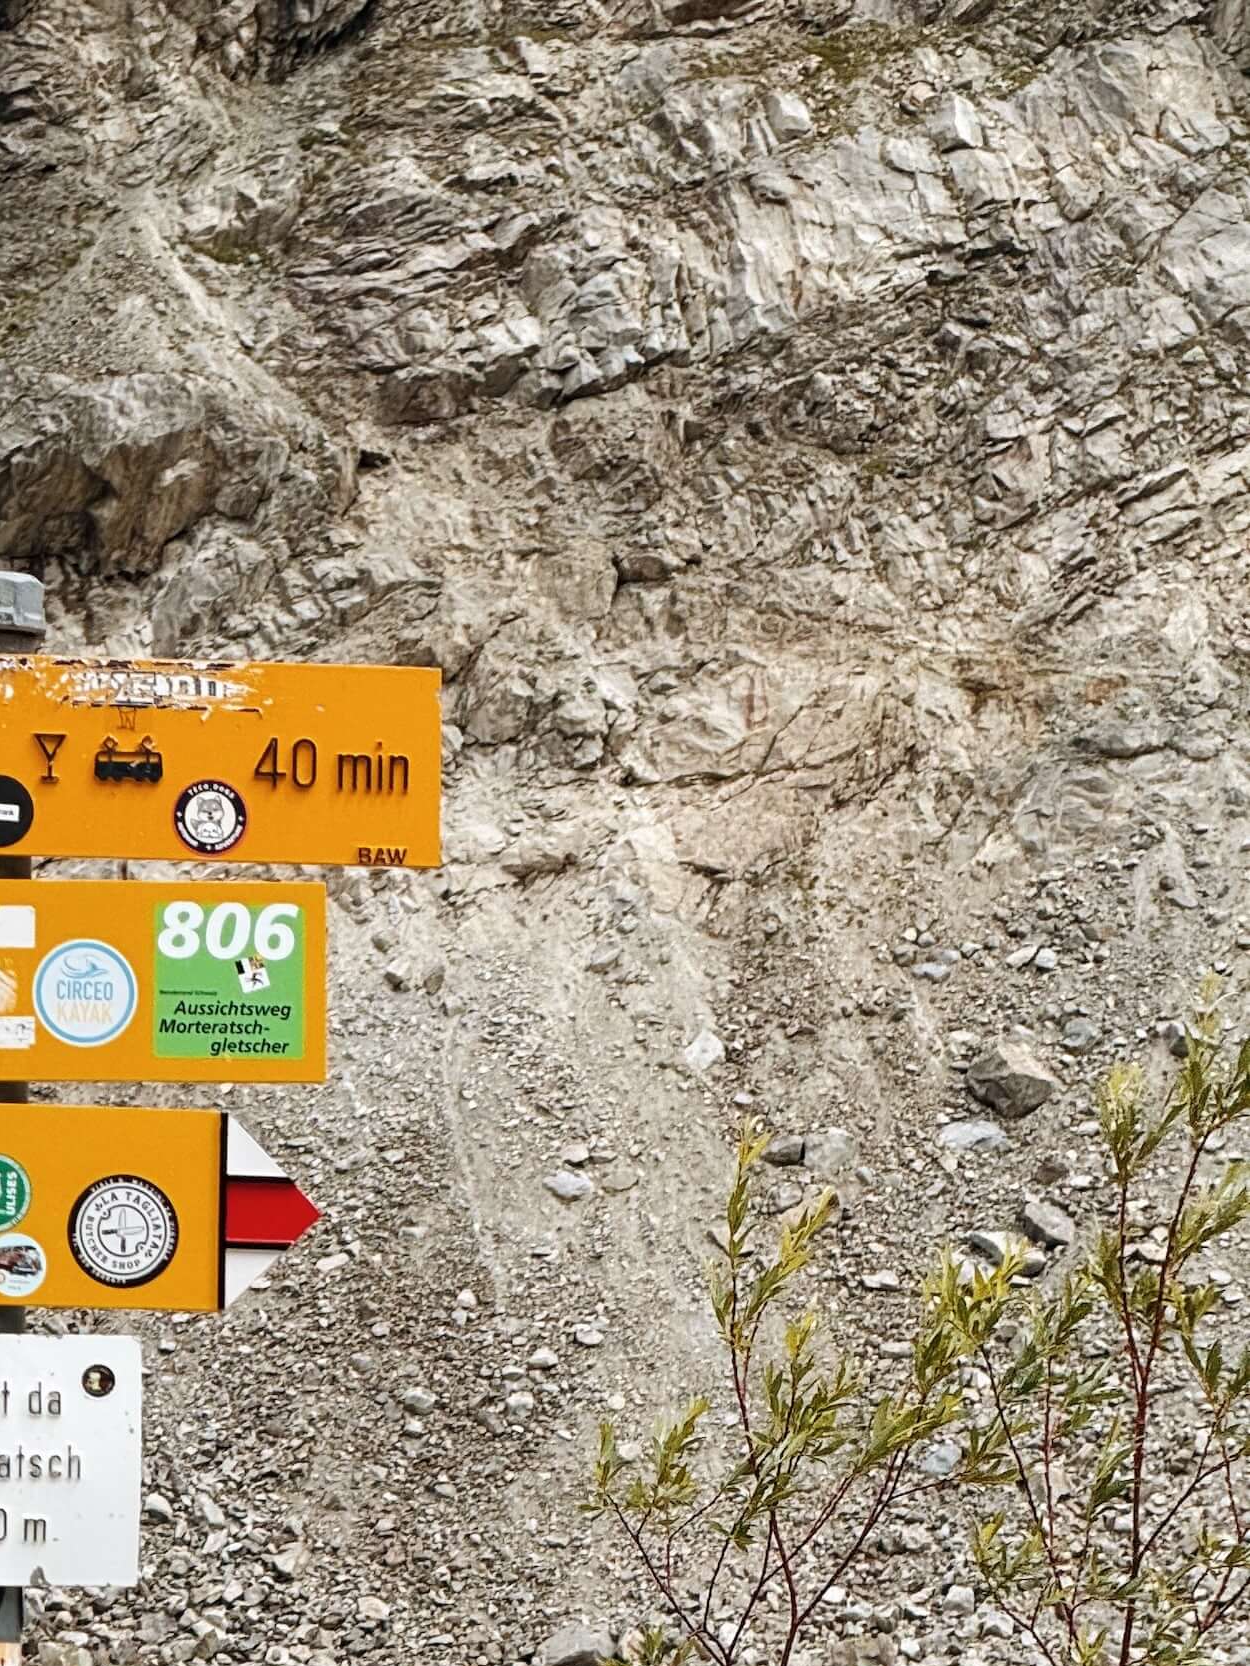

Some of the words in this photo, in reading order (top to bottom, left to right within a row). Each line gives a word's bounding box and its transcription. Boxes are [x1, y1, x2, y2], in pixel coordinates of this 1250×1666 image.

[254, 737, 318, 790] 40
[337, 741, 410, 794] min
[358, 847, 408, 865] BAW
[158, 901, 299, 960] 806
[56, 980, 114, 1001] CIRCEO
[57, 1001, 112, 1025] KAYAK
[174, 1000, 291, 1020] Aussichtsweg
[159, 1018, 270, 1035] Morteratsch-
[210, 1038, 289, 1056] gletscher
[5, 1171, 17, 1216] ULISES
[101, 1192, 118, 1205] LA
[125, 1191, 162, 1250] TAGLIATA
[111, 1259, 141, 1270] SHOP
[28, 1381, 62, 1416] da
[23, 1517, 47, 1542] m
